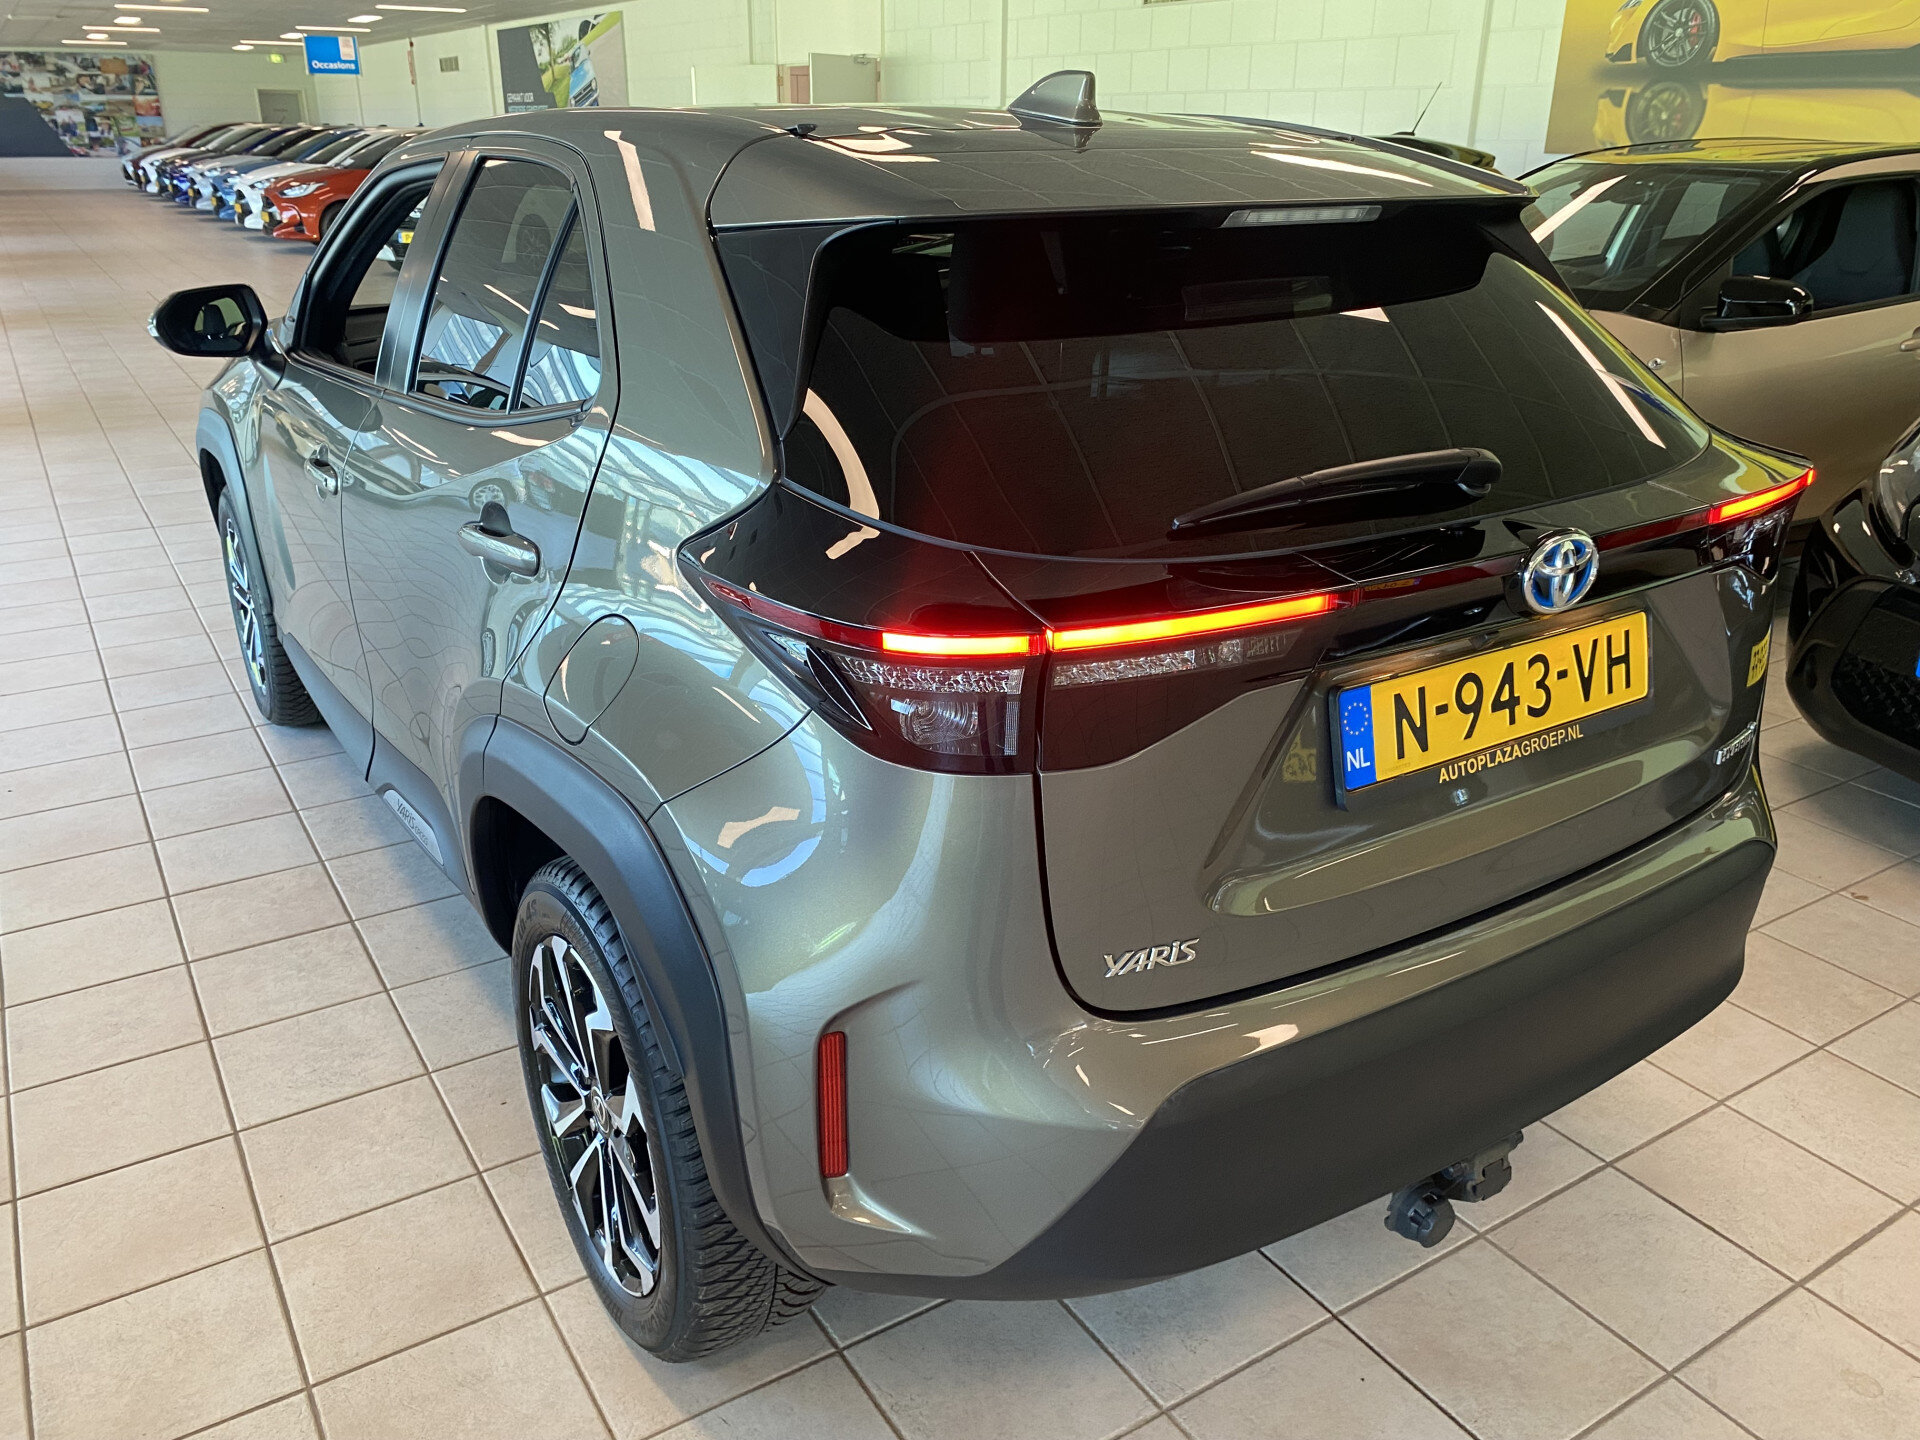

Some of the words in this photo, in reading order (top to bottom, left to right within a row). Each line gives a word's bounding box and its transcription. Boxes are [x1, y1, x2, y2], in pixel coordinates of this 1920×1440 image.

[311, 60, 356, 70] Occasions
[1393, 629, 1631, 760] N-943-VH
[1346, 747, 1371, 772] NL
[1438, 724, 1584, 784] AUTOPLAZAGROEP.NL
[1103, 938, 1200, 978] YARIS
